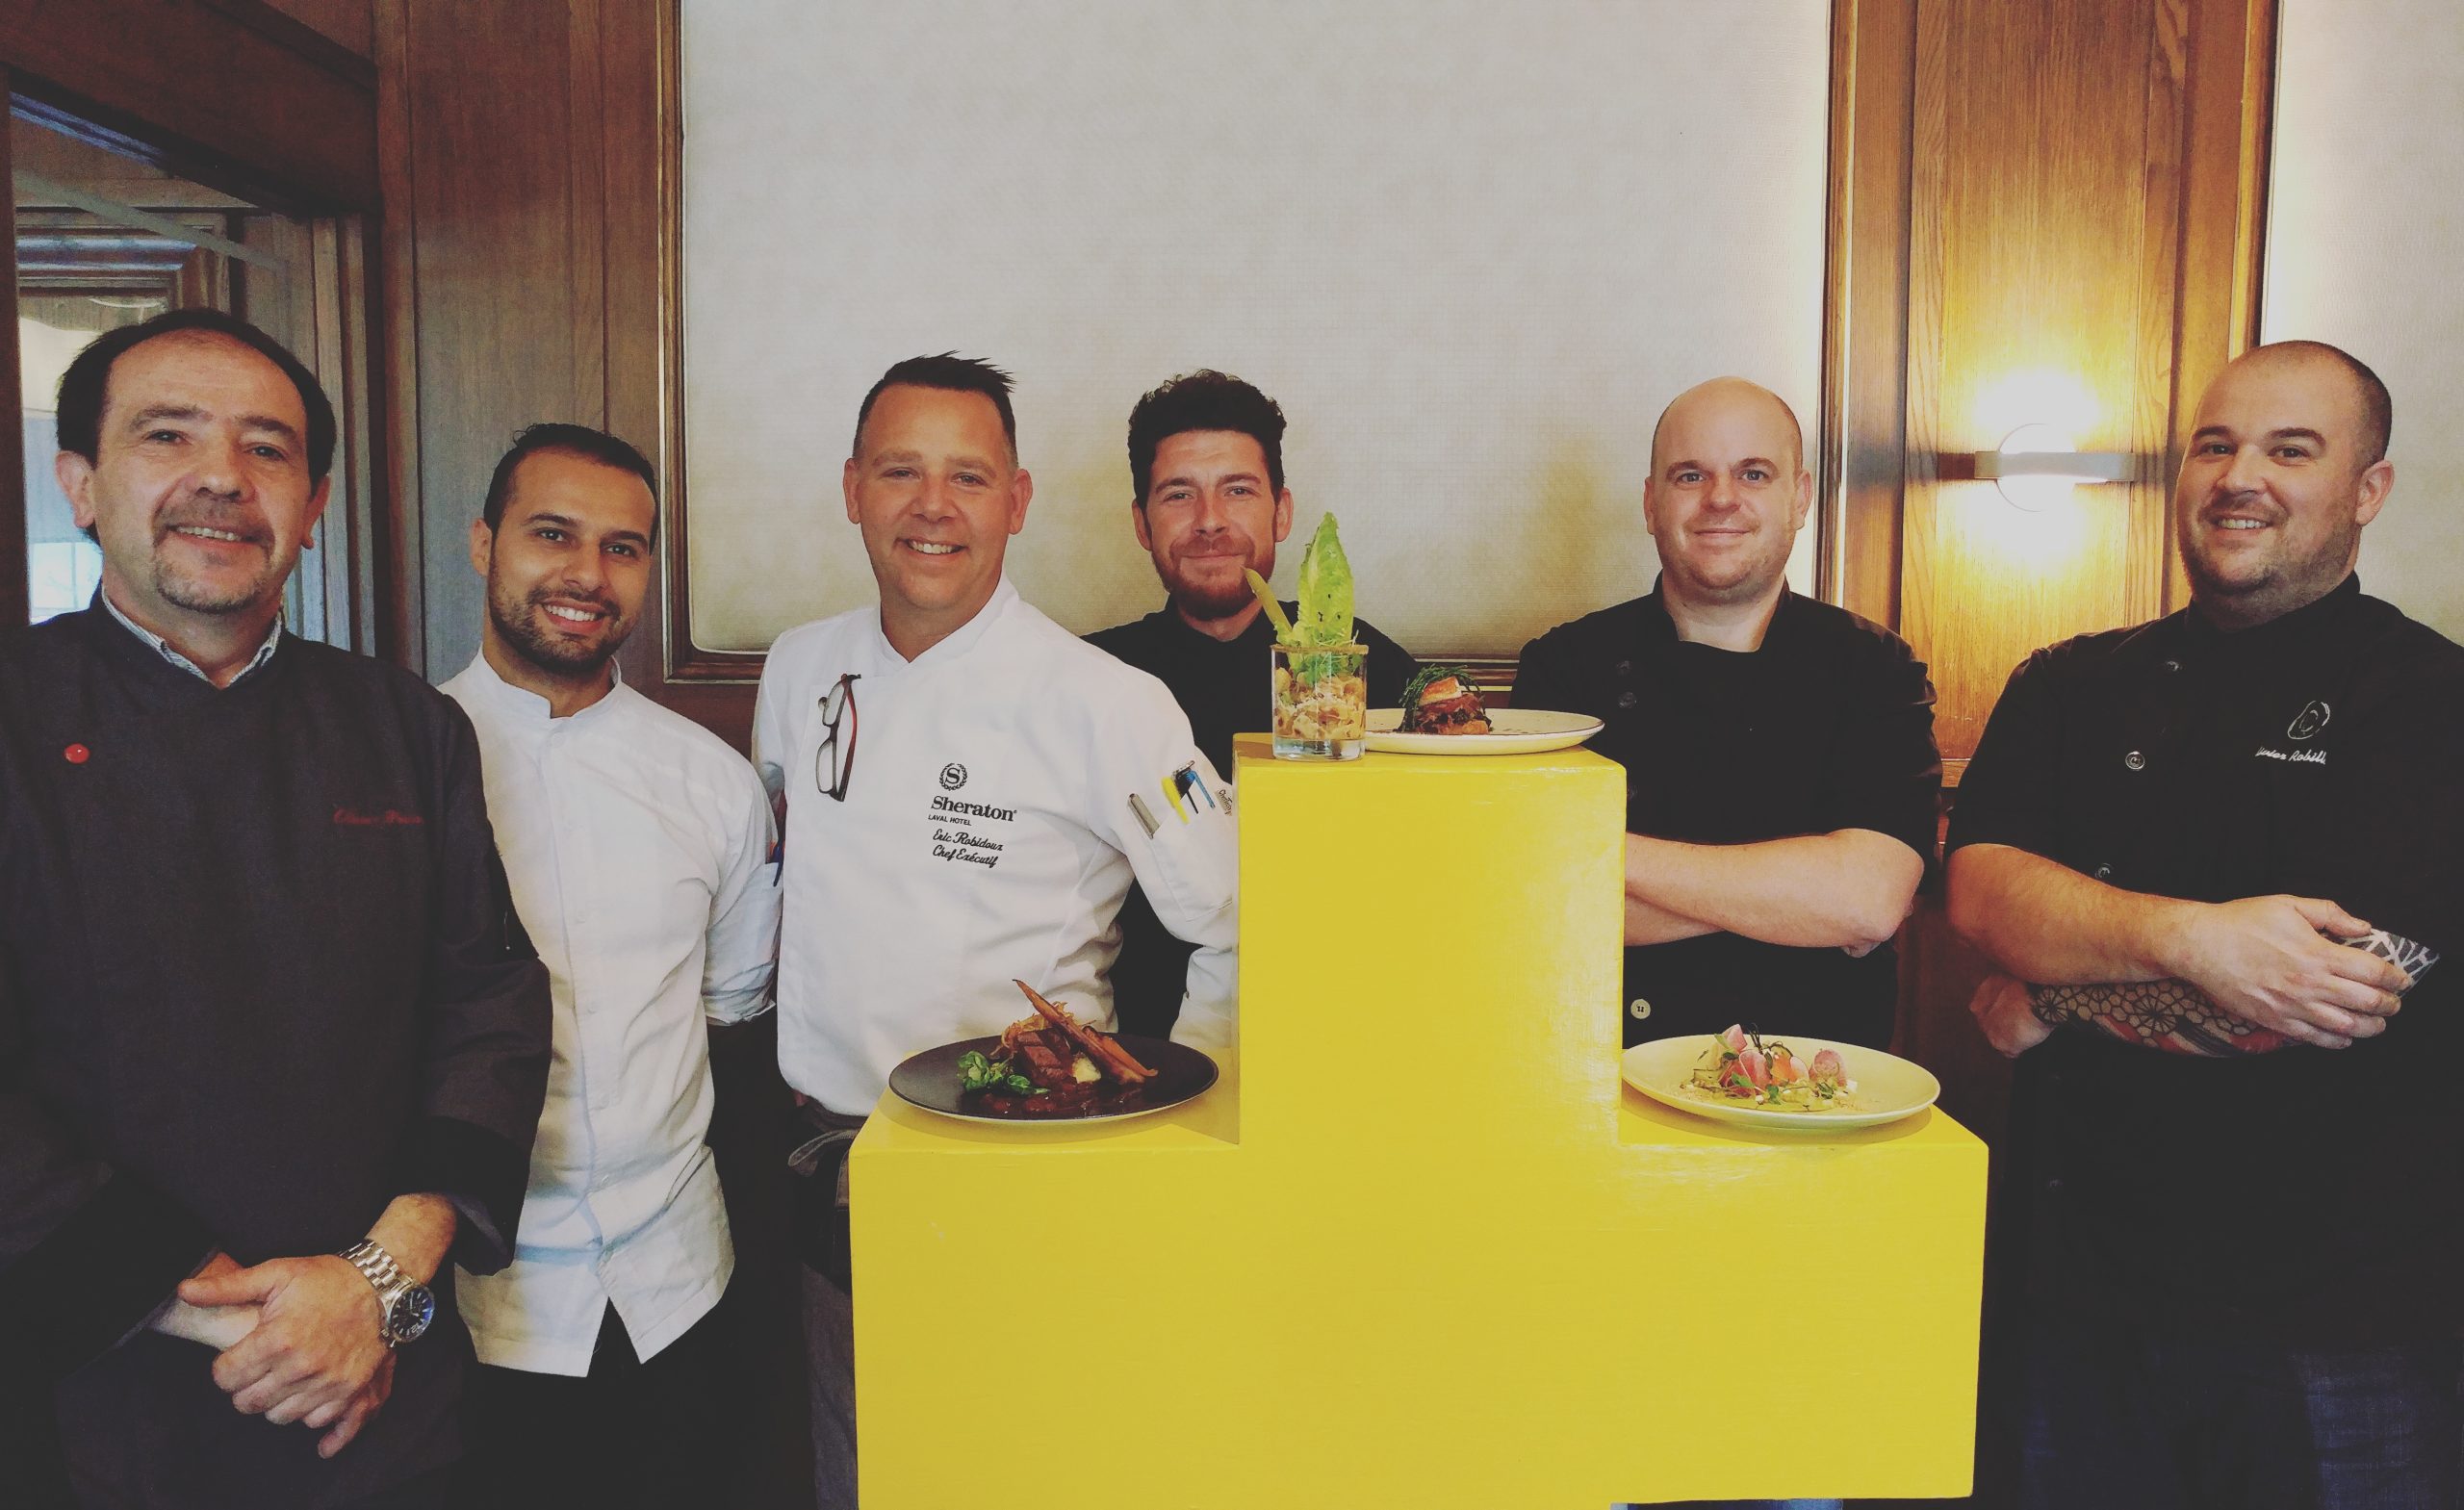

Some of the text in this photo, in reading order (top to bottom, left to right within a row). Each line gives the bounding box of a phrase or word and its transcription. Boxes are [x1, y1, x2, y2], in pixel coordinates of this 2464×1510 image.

[944, 767, 961, 784] S
[928, 814, 972, 826] LAVAL HOTEL
[931, 795, 1014, 822] Sheraton
[933, 828, 1004, 851] Eric Robidoux
[932, 844, 999, 868] Chef Exécutif
